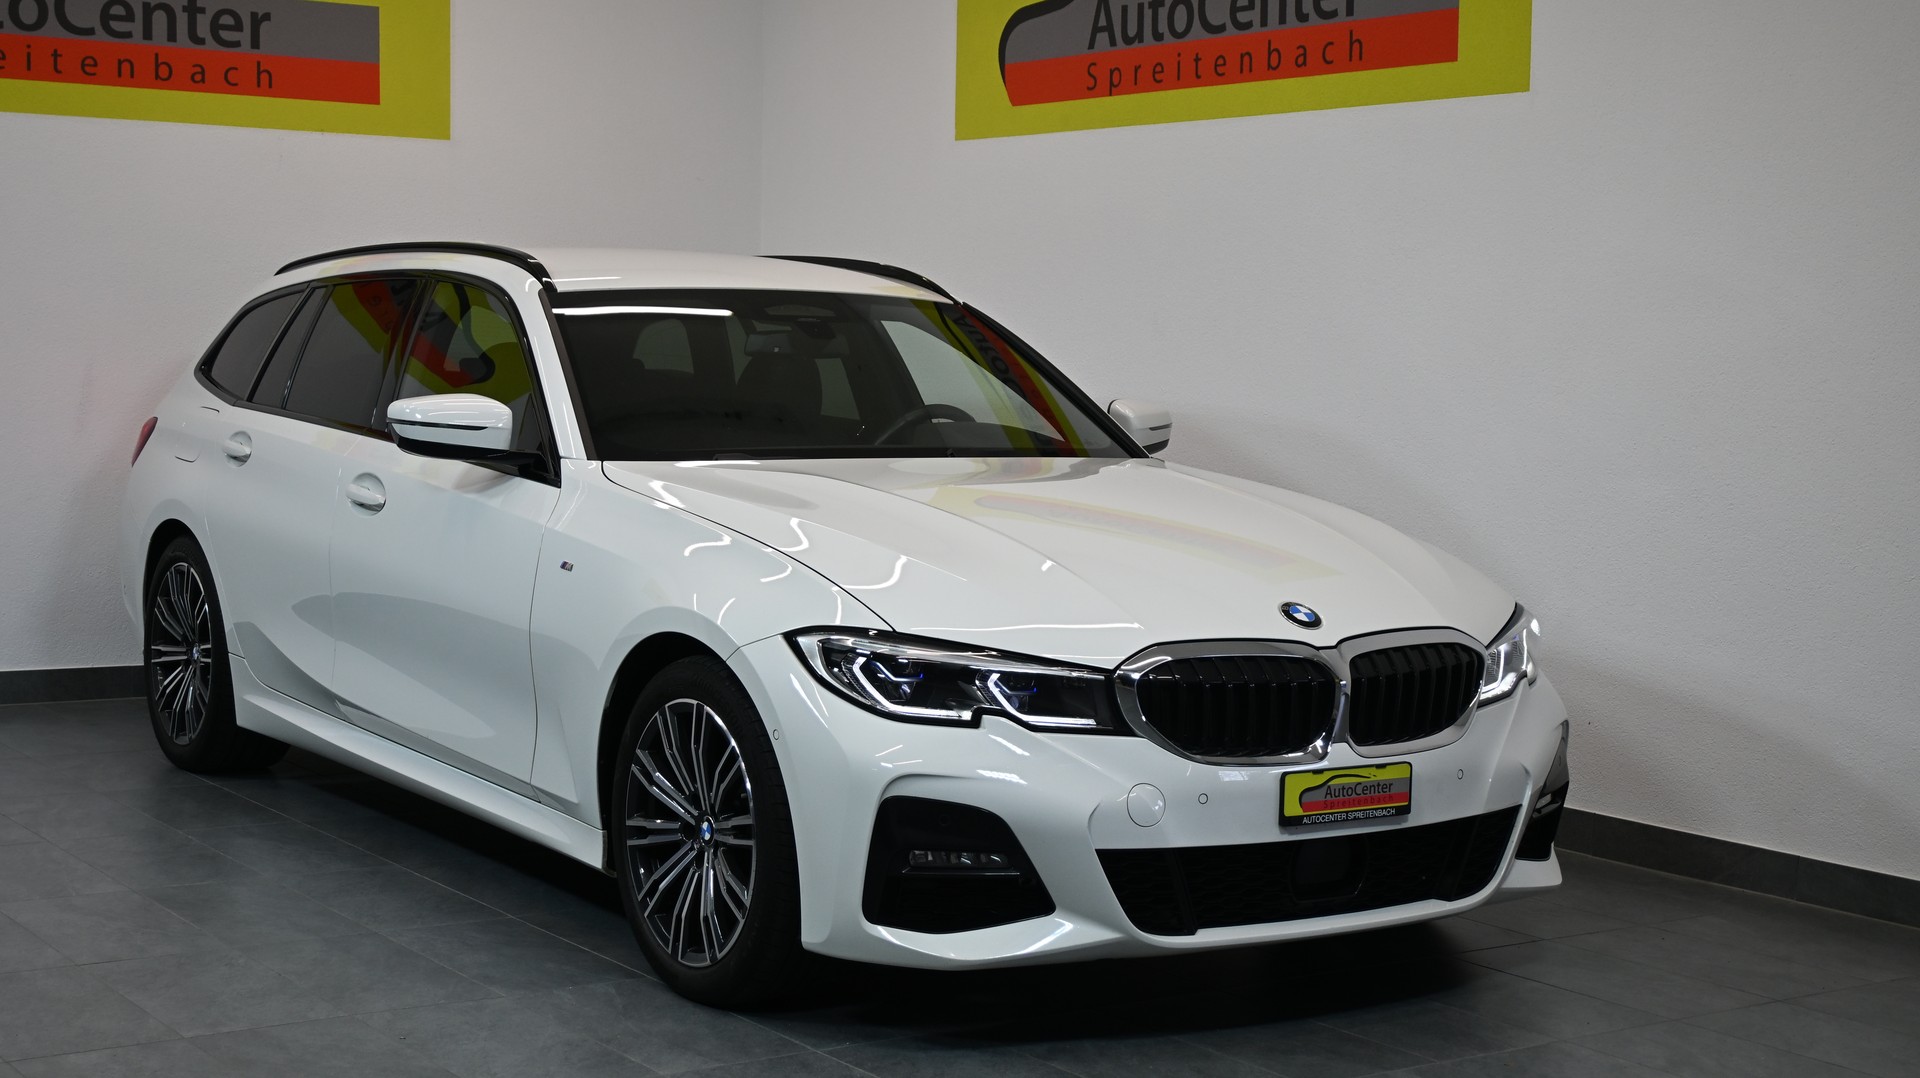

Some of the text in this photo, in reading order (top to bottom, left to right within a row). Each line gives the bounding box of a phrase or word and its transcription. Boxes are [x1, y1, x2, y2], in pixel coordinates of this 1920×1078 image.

[0, 0, 272, 50] oCenter
[1086, 29, 1364, 97] Spreitenbach
[1324, 782, 1394, 799] AutoCenter
[1323, 795, 1394, 810] Spreitenbach
[1302, 808, 1396, 825] AUTOCENTER SPREITENBACH
